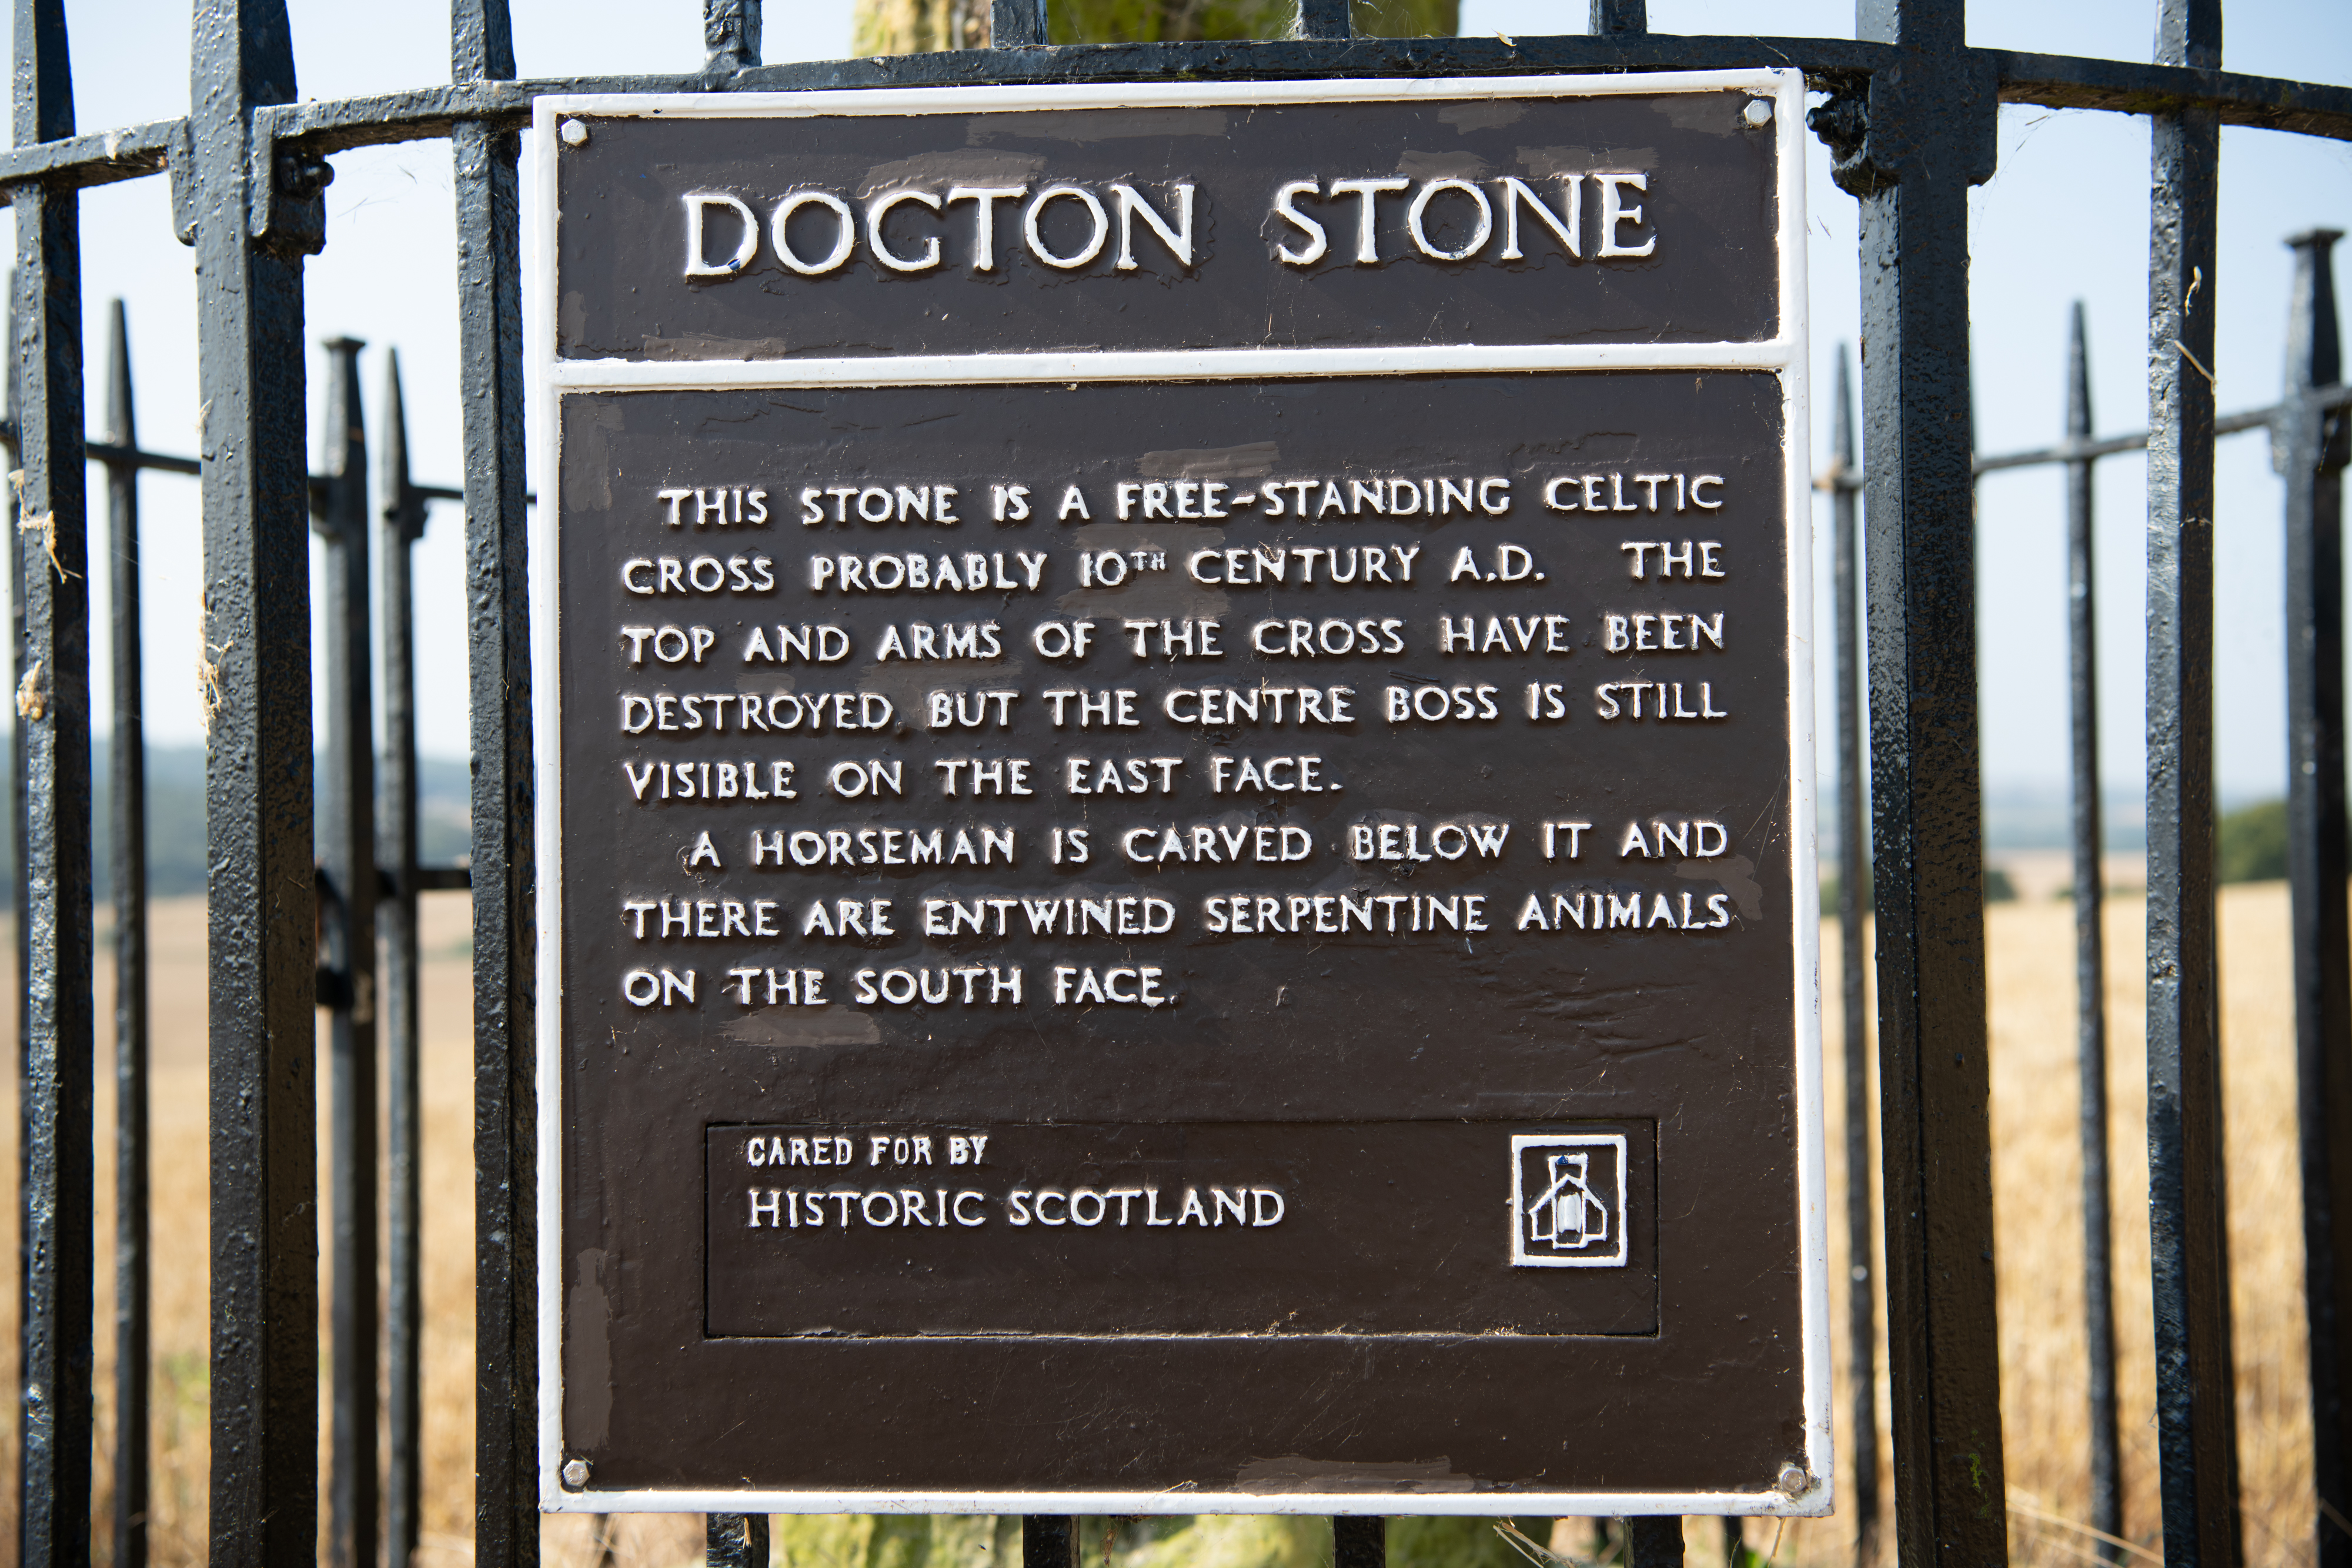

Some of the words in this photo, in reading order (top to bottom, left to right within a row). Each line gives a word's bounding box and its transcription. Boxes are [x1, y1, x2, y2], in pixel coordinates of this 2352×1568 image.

[680, 176, 1195, 276] DOGTON
[1272, 169, 1656, 264] STONE
[656, 484, 767, 524] THIS
[799, 484, 959, 524] STONE
[991, 484, 1031, 521] IS
[1057, 484, 1090, 519] A
[1115, 474, 1511, 520] FREE-STANDING
[1544, 472, 1723, 511] CELTIC
[620, 555, 774, 593] CROSS
[810, 551, 1047, 591] PROBABLY
[1078, 551, 1166, 587] 10TH
[1185, 544, 1419, 583] CENTURY
[1451, 544, 1545, 581] A.D.
[1621, 541, 1725, 578] THE
[620, 625, 714, 662] TOP
[743, 625, 849, 662] AND
[876, 620, 1001, 661] ARMS
[1031, 619, 1095, 657] OF
[1122, 618, 1223, 657] THE
[1250, 618, 1405, 657] CROSS
[1439, 615, 1569, 653] HAVE
[1605, 613, 1724, 651] BEEN
[926, 689, 1018, 727] BUT
[1042, 689, 1140, 726] THE
[1163, 687, 1355, 724] CENTRE
[1385, 684, 1498, 723] BOSS
[1527, 681, 1565, 720] IS
[1596, 682, 1728, 718] STILL
[622, 761, 797, 799] VISIBLE
[827, 759, 903, 797] ON
[934, 758, 1033, 795] THE
[1066, 757, 1183, 793] EAST
[1210, 755, 1342, 793] FACE.
[690, 831, 720, 867] A
[750, 827, 1014, 865] HORSEMAN
[1051, 827, 1089, 864] IS
[1121, 822, 1312, 862] CARVED
[1348, 823, 1509, 862] BELOW
[1543, 821, 1592, 858] IT
[1622, 820, 1728, 857] AND
[622, 898, 780, 939] THERE
[803, 897, 895, 936] ARE
[921, 897, 1175, 936] ENTWINED
[1204, 894, 1488, 932] SERPENTINE
[1518, 892, 1729, 930] ANIMALS
[622, 967, 696, 1006] ON
[727, 967, 827, 1004] THE
[854, 966, 1022, 1004] SOUTH
[1053, 967, 1181, 1007] FACE.
[747, 1136, 853, 1166] CARED
[870, 1136, 933, 1166] FOR
[949, 1136, 988, 1164] BY
[748, 1189, 986, 1227] HISTORIC
[1008, 1188, 1285, 1226] SCOTLAND
